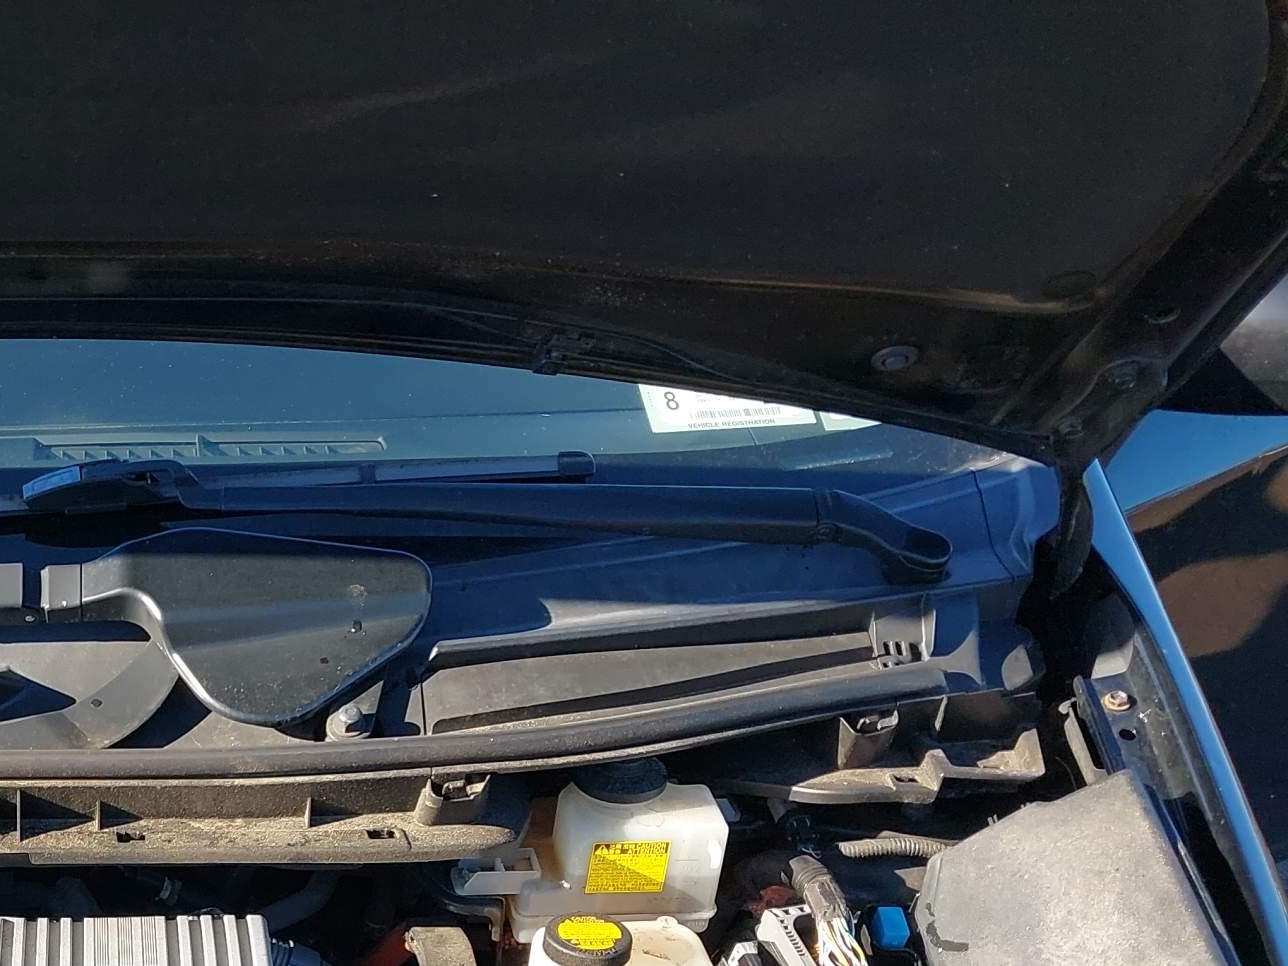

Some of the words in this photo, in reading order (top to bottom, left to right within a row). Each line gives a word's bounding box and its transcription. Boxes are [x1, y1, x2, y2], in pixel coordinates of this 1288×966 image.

[663, 391, 679, 411] 8
[687, 422, 720, 430] VEHICLE
[721, 418, 777, 428] REGISTRATION
